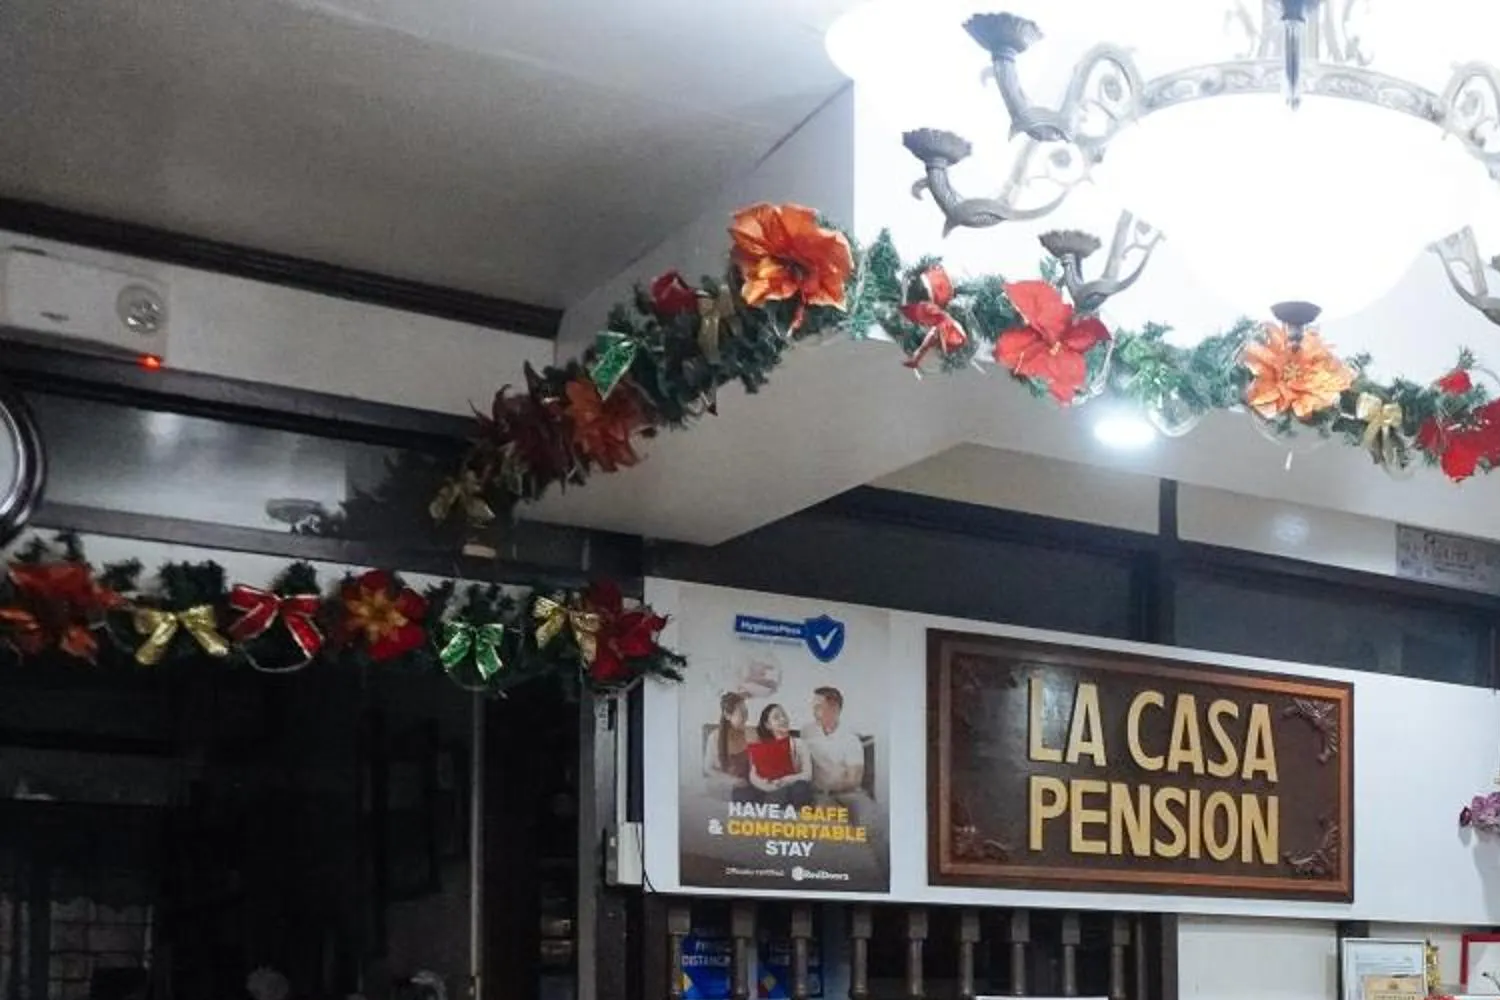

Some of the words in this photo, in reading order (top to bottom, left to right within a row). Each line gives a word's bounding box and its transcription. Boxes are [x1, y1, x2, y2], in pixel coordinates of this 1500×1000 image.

[1029, 677, 1107, 767] LA
[1127, 690, 1279, 783] CASA
[728, 801, 781, 819] HAVE
[783, 804, 798, 820] A
[800, 805, 849, 823] SAFE
[1029, 775, 1280, 865] PENSION
[708, 818, 724, 836] &
[727, 819, 868, 842] COMFORTABLE
[765, 840, 815, 857] STAY
